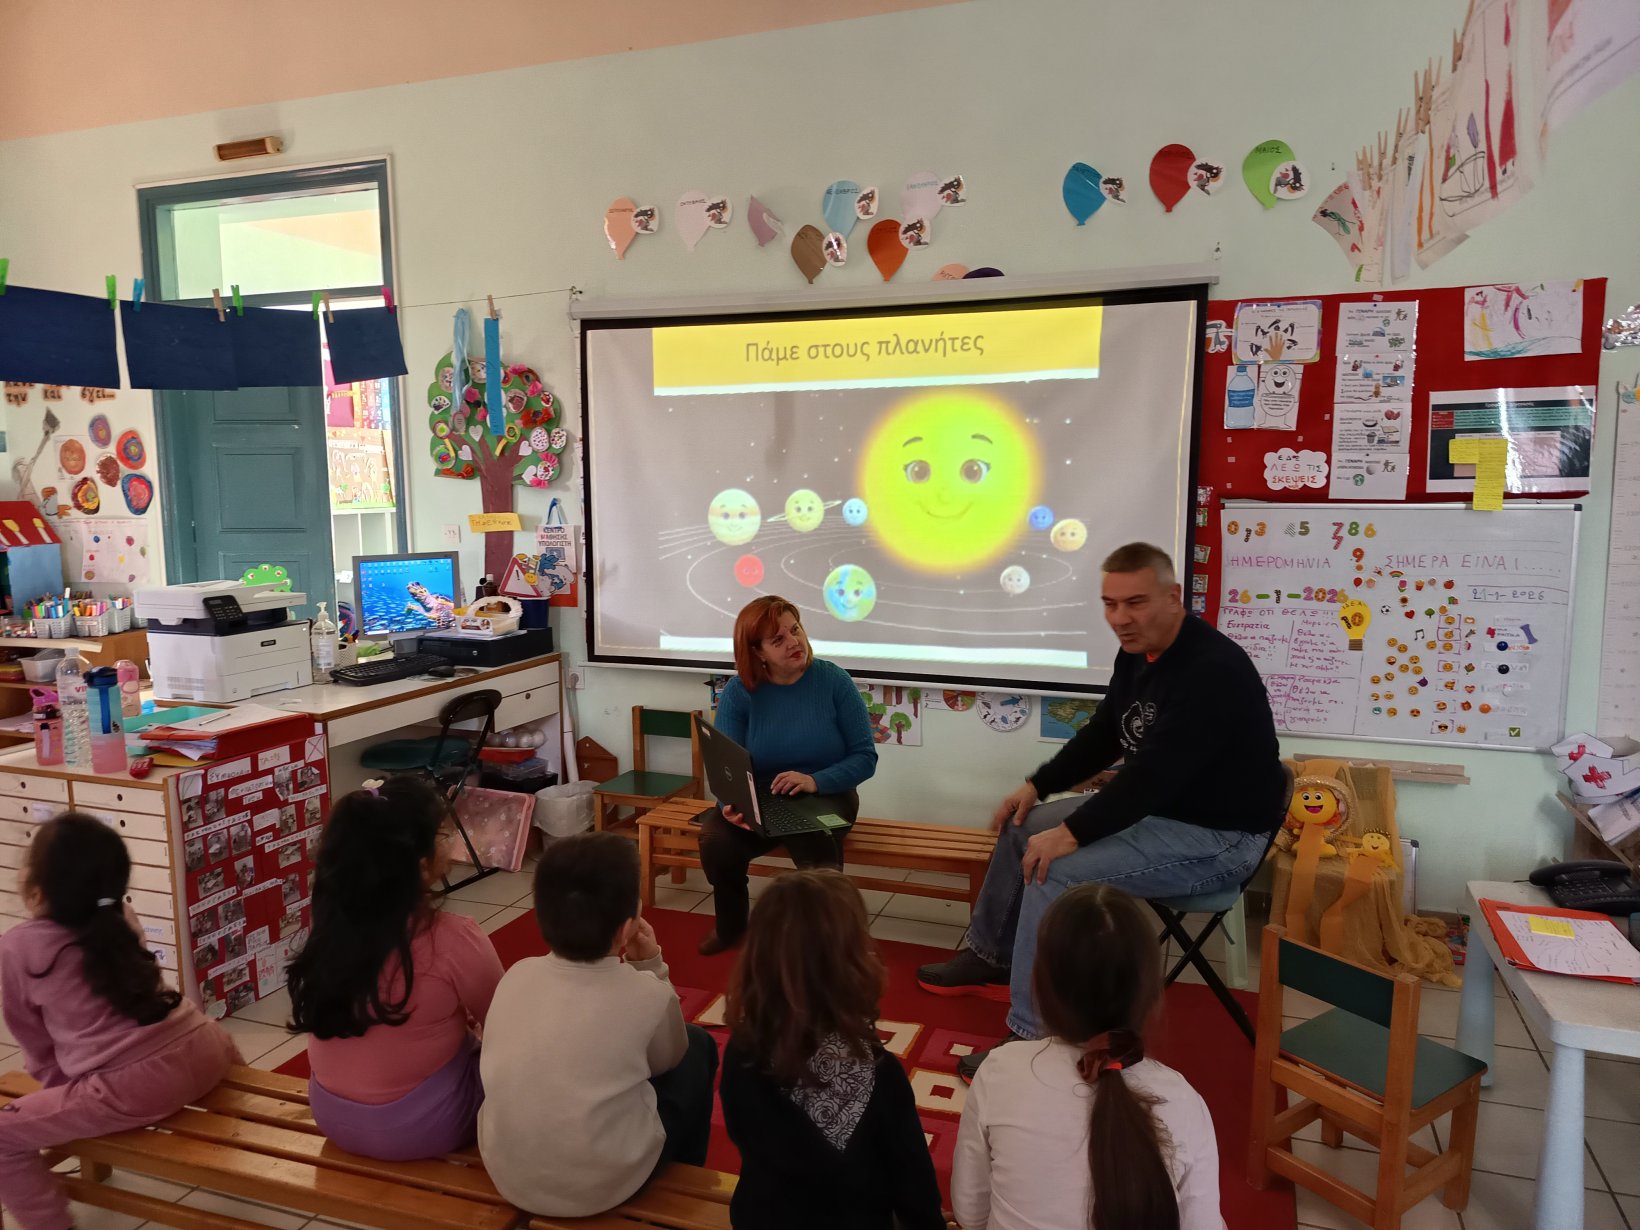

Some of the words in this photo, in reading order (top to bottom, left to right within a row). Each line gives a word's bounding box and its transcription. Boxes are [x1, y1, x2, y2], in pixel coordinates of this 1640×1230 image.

[745, 340, 800, 366] Πάμε
[807, 340, 870, 361] στους
[876, 331, 985, 358] πλανήτες
[1272, 474, 1317, 485] ΣΚΕΨΕΙΣ
[1230, 555, 1331, 570] ΗΜΕΡΟΜΗΝΙΑ
[1385, 554, 1449, 569] ΣΗΜΕΡΑ
